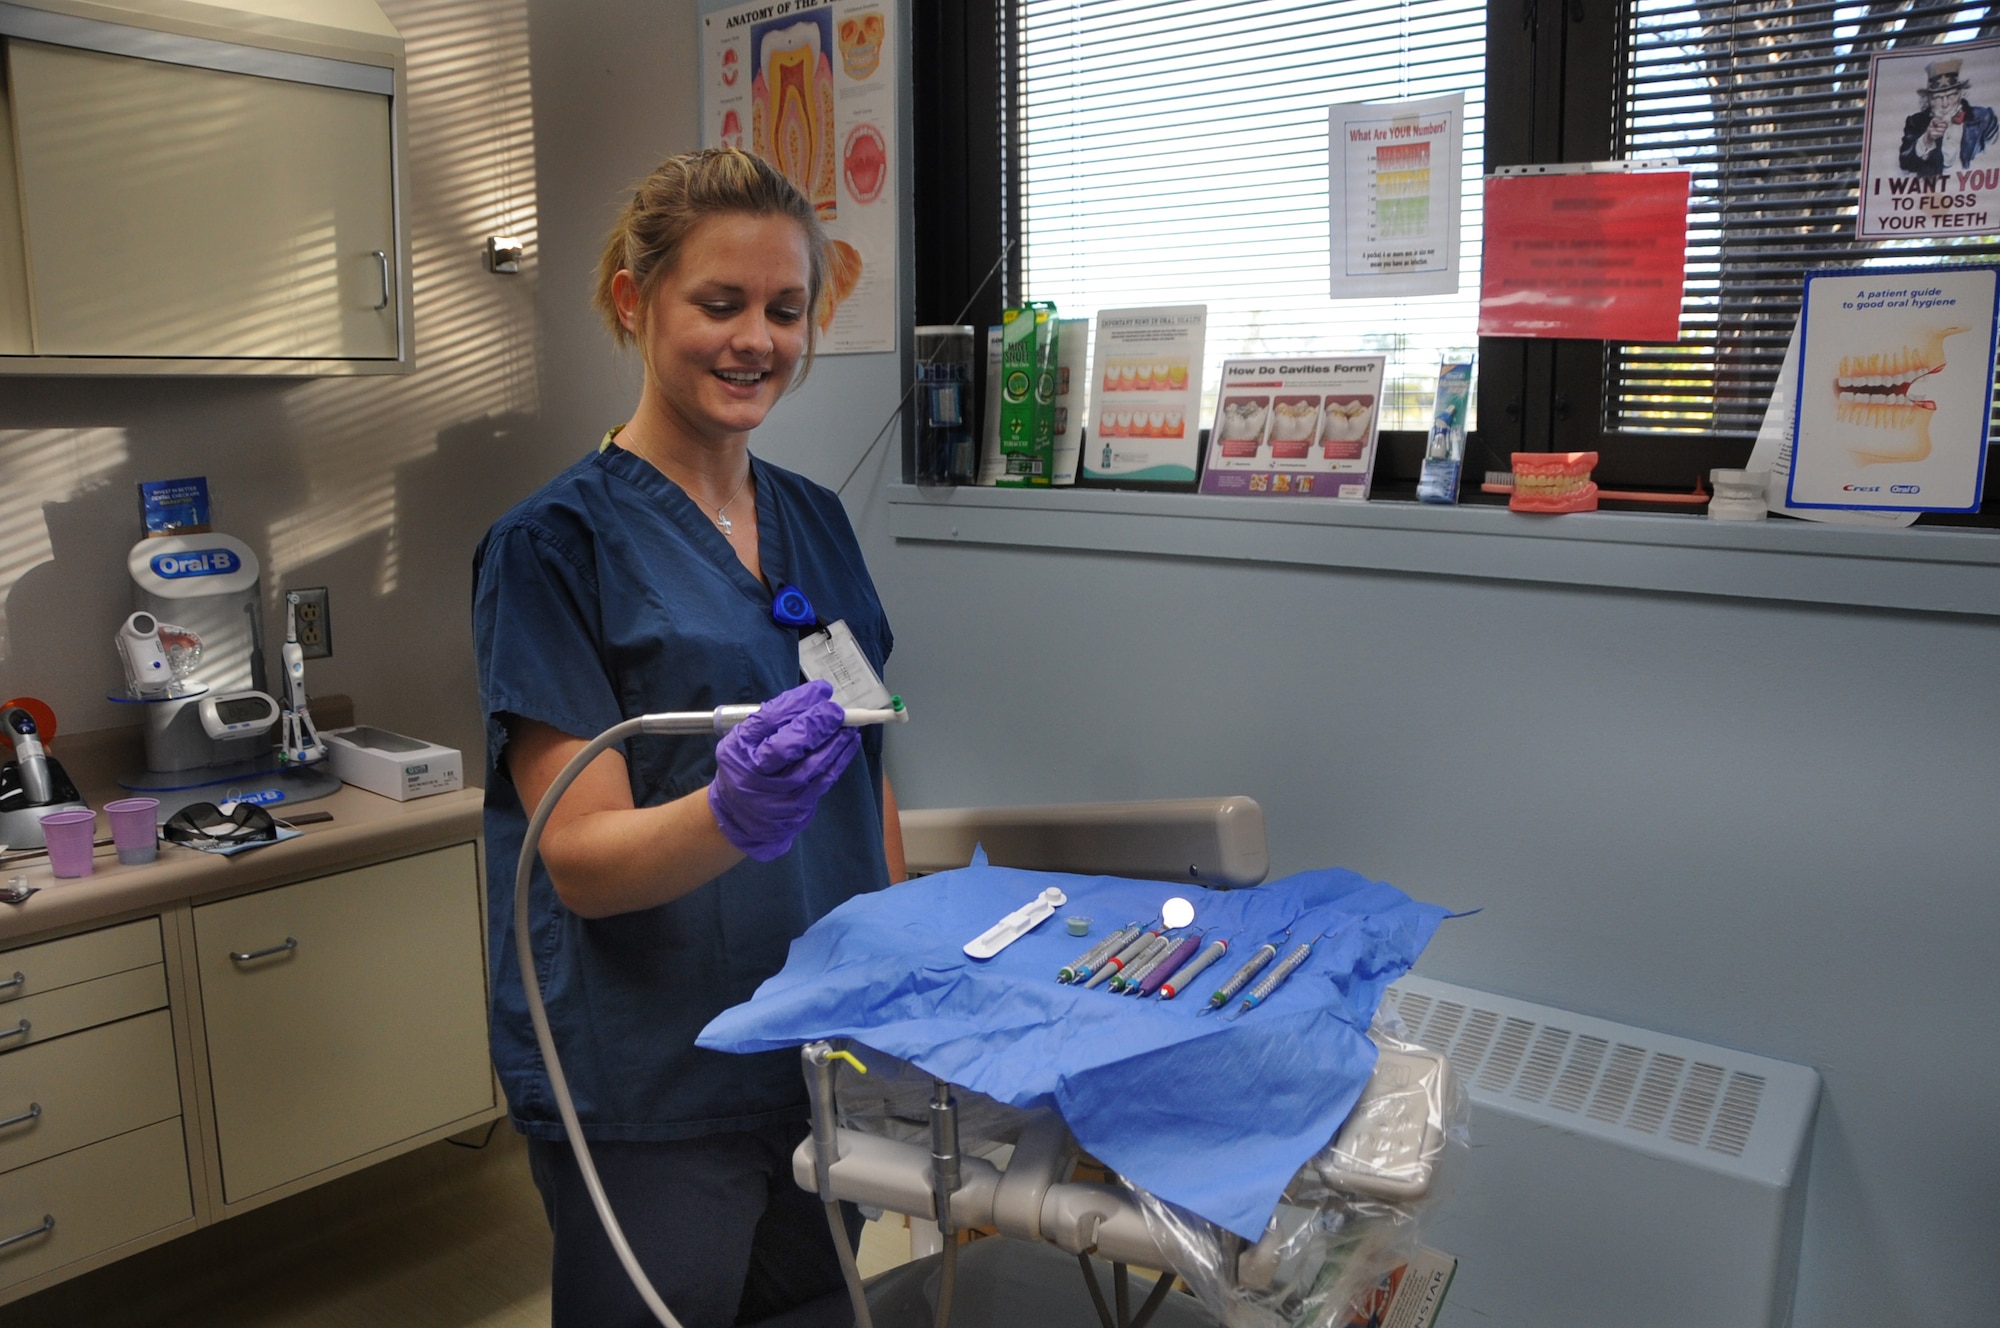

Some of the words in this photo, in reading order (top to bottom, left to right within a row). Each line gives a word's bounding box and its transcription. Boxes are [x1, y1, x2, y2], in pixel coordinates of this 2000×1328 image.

[726, 6, 774, 29] ANATOMY
[777, 0, 791, 15] OF
[1350, 128, 1371, 142] What
[1374, 128, 1387, 140] Are
[1389, 125, 1411, 139] YOUR
[1413, 119, 1447, 137] Numbers?
[1874, 178, 1881, 195] I
[1888, 175, 1951, 195] WANT
[1956, 168, 2000, 191] YOU
[1891, 197, 1914, 211] TO
[1919, 194, 1977, 210] FLOSS
[1878, 215, 1926, 230] YOUR
[1931, 212, 1988, 228] TEETH
[1867, 289, 1907, 299] patient
[1910, 288, 1942, 299] guide
[1856, 300, 1884, 310] good
[1887, 299, 1909, 308] oral
[1912, 298, 1956, 309] hygiene
[1228, 366, 1255, 376] How
[1258, 366, 1275, 375] Do
[1279, 364, 1330, 375] Cavities
[1334, 363, 1376, 374] Form?
[1842, 484, 1881, 492] Crest
[159, 553, 231, 574] Oral-B
